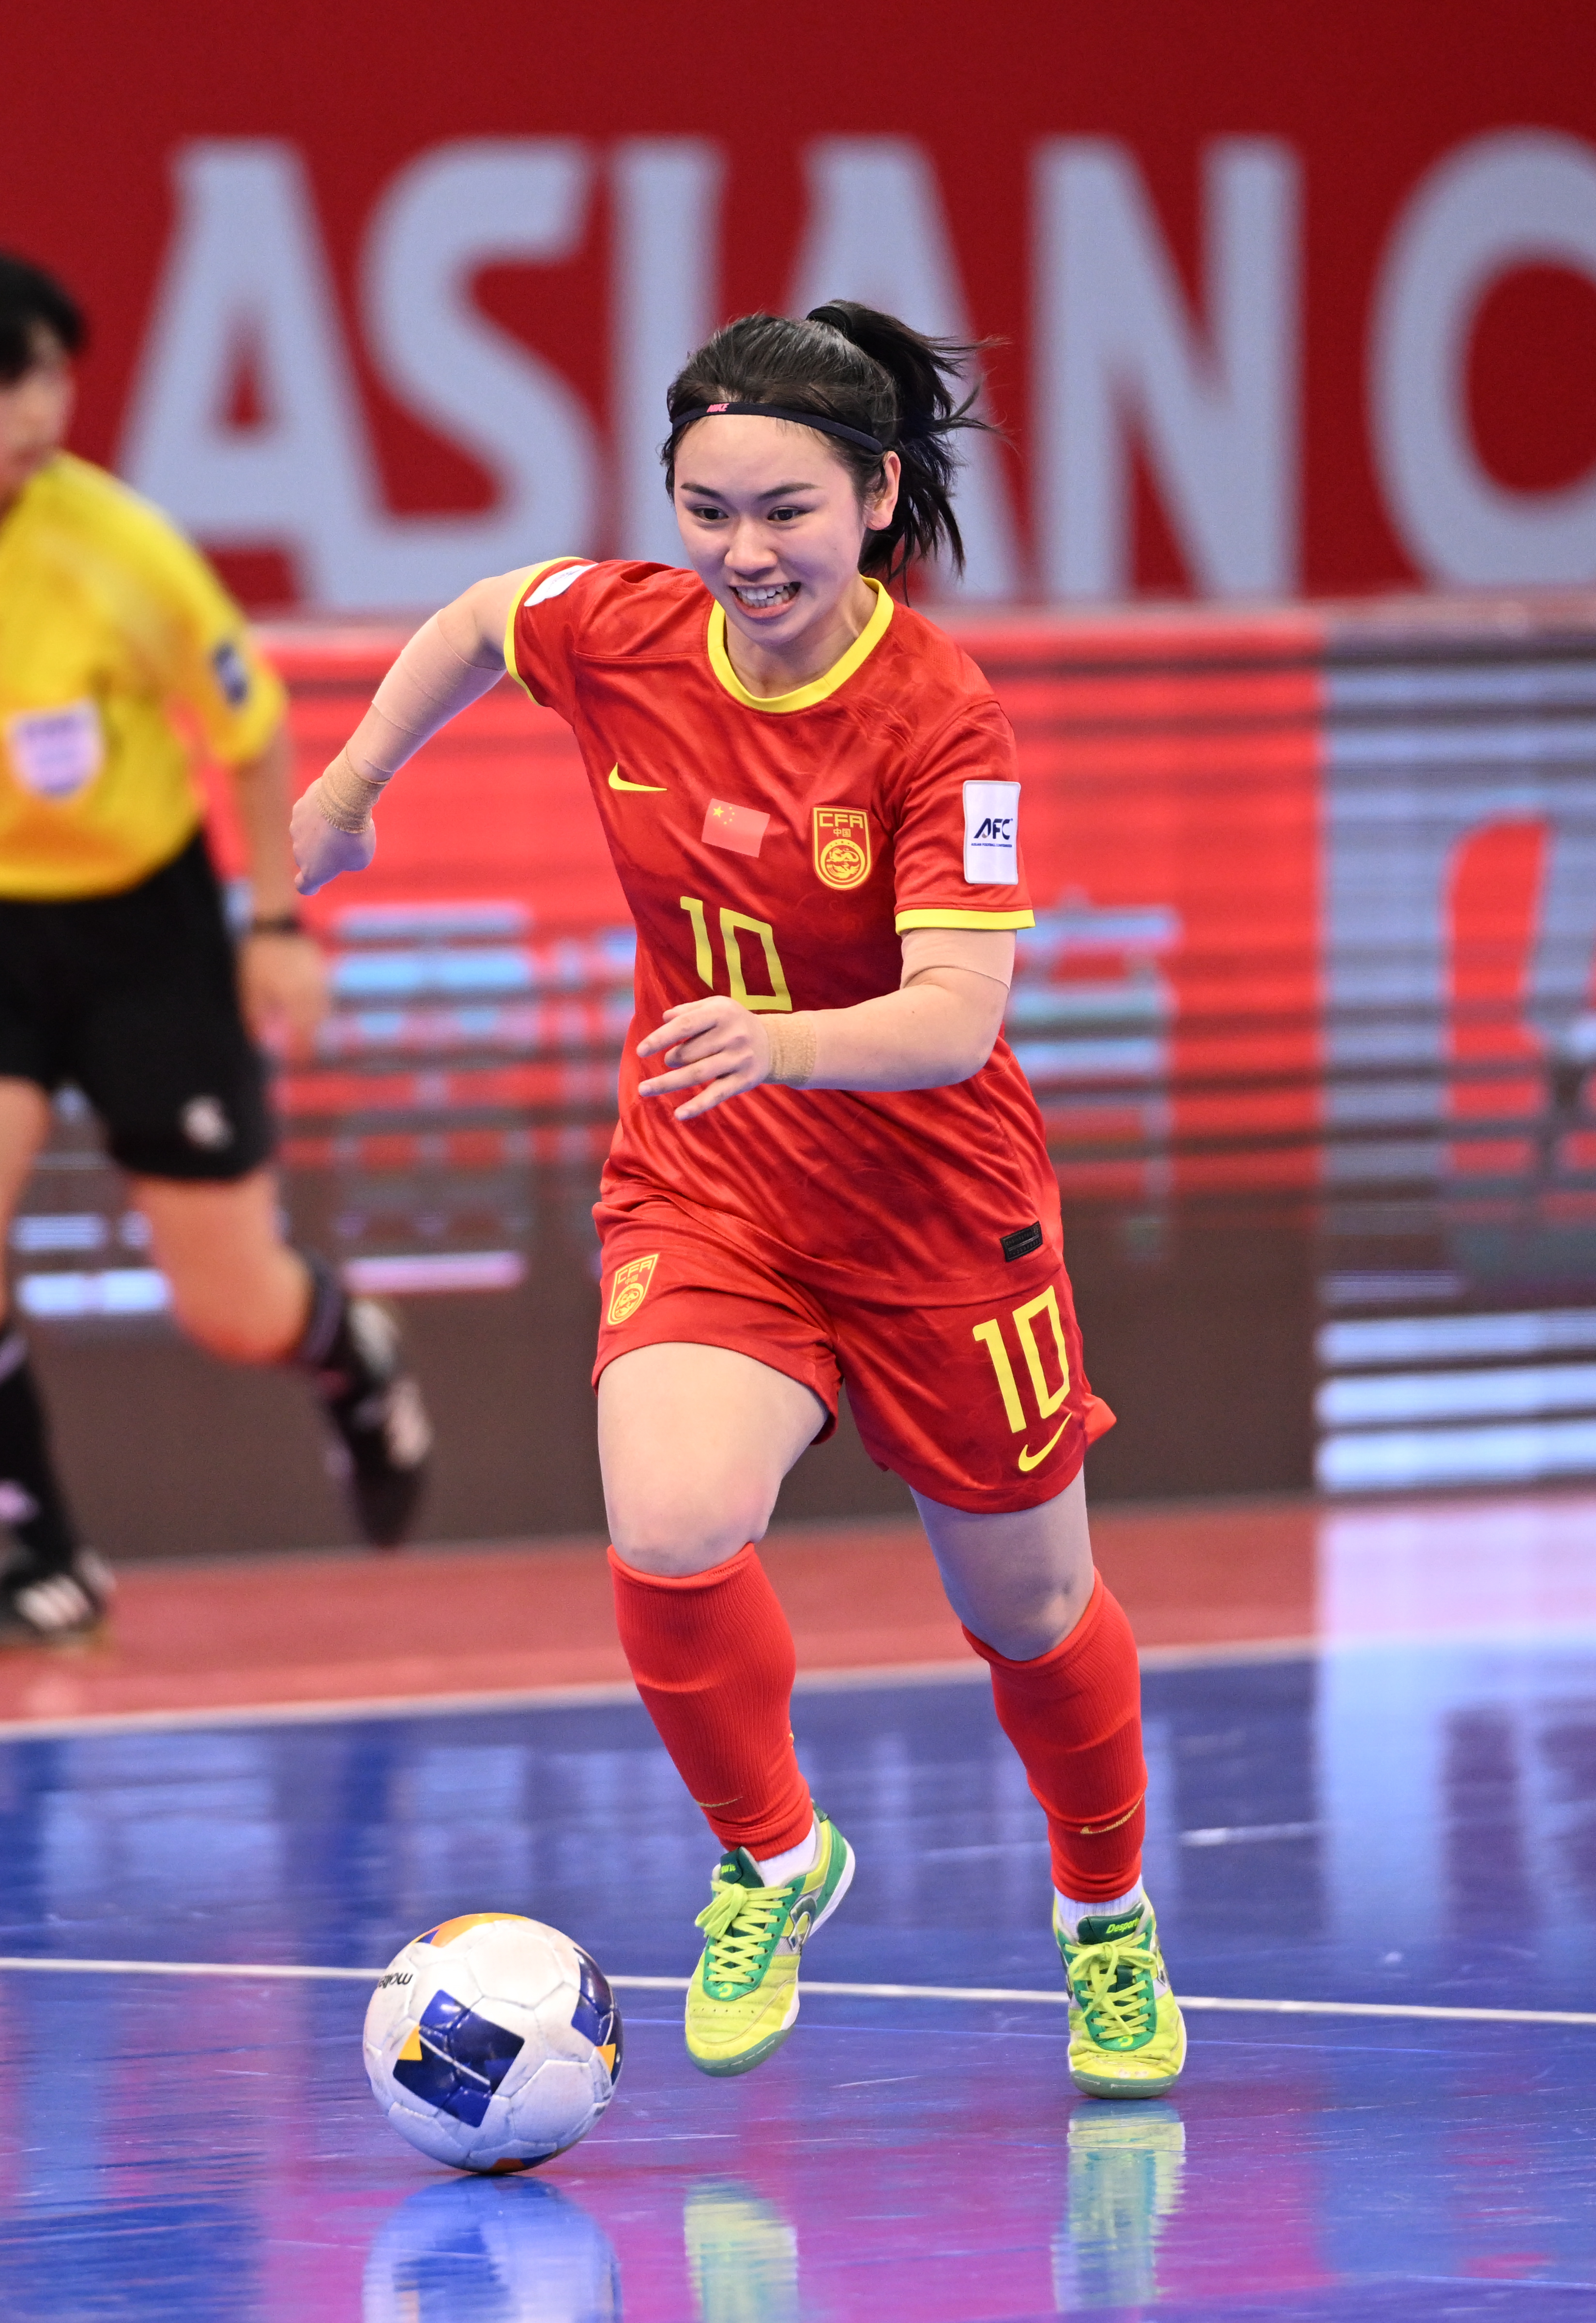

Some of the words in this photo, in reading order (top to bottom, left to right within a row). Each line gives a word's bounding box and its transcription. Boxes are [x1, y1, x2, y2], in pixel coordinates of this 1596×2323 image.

[114, 137, 1302, 608] ASIAN
[819, 813, 864, 828] CFA
[833, 828, 851, 837] 中国
[973, 818, 1011, 840] AFC
[680, 896, 792, 1011] 10
[618, 1260, 653, 1284] CFA
[973, 1285, 1070, 1433] 10
